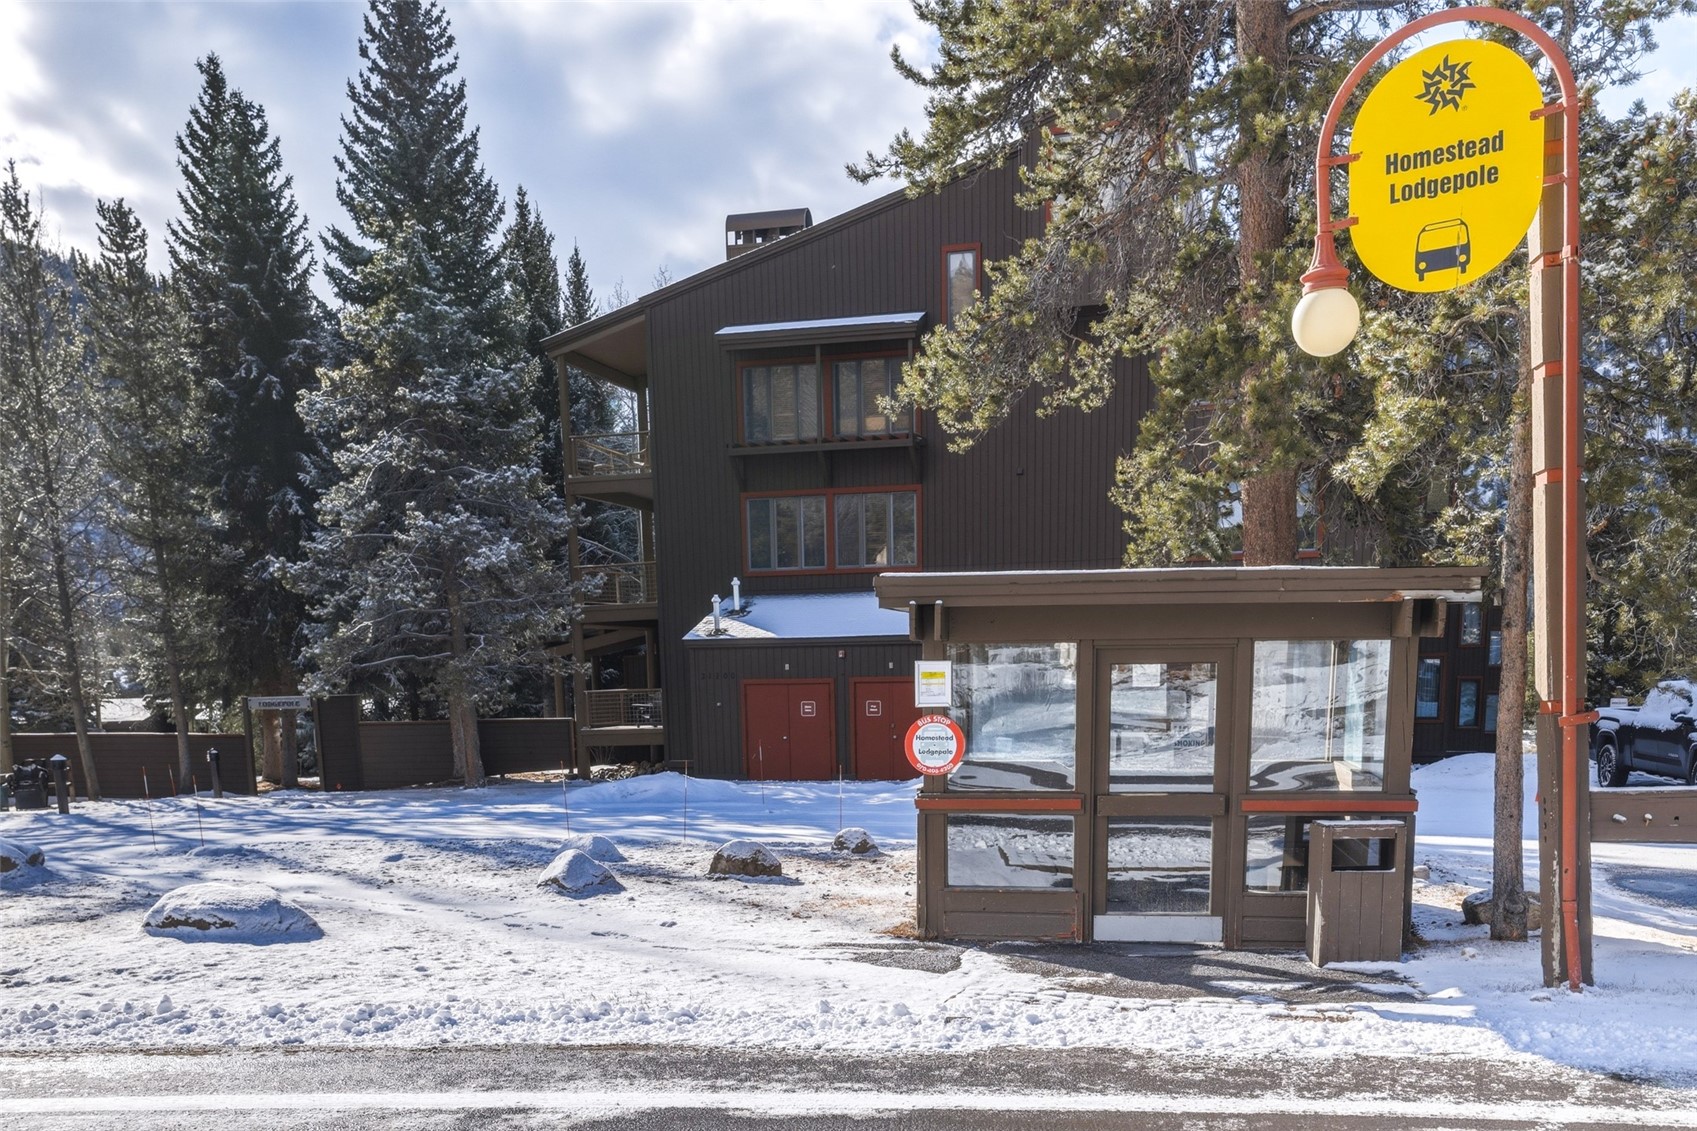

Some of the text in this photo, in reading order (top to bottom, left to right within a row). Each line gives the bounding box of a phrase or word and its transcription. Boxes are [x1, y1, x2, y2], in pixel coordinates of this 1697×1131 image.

[1385, 130, 1504, 175] Homestead
[1389, 165, 1499, 204] Lodgepole
[258, 700, 301, 708] LODGEPOLE
[917, 714, 951, 727] BUS STOP
[918, 748, 953, 756] Lodgepole
